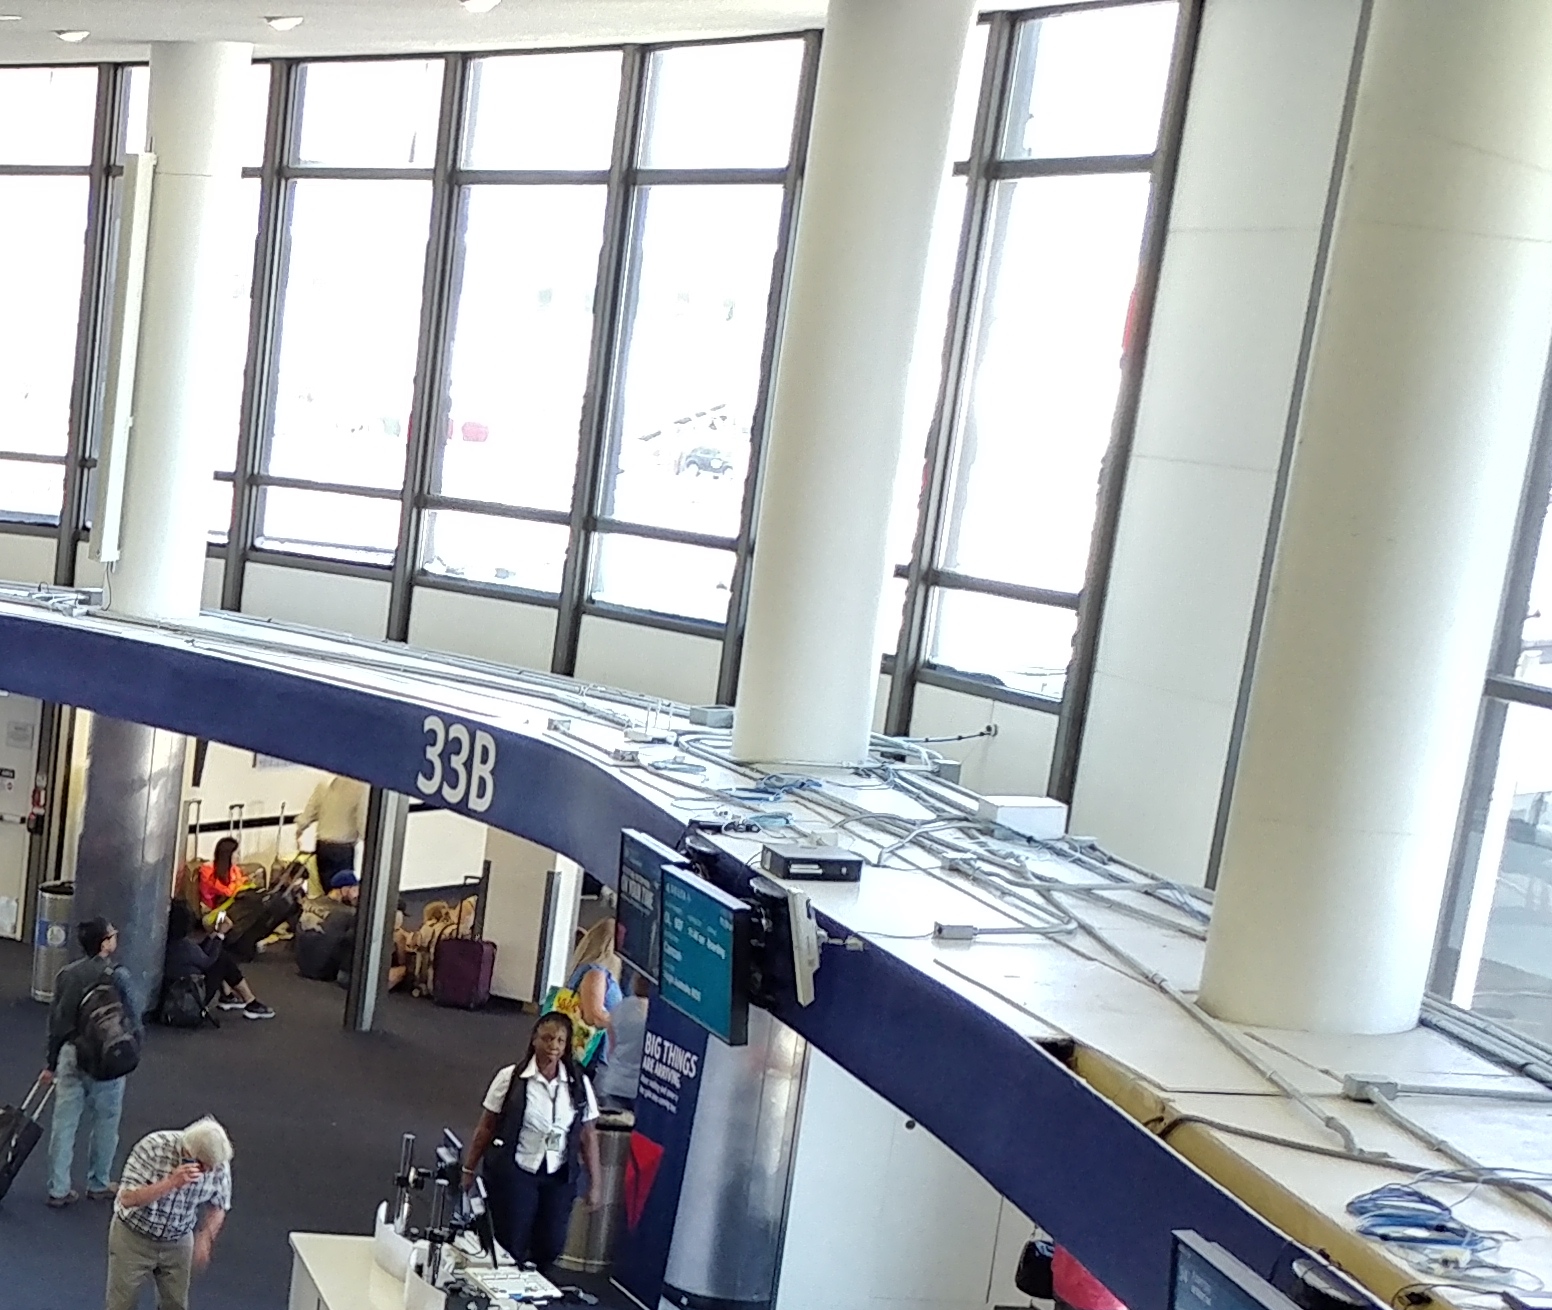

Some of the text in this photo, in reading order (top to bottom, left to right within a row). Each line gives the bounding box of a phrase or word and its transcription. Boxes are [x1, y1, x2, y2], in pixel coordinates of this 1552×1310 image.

[416, 714, 497, 814] 33B
[642, 1054, 656, 1074] ARE
[644, 1030, 699, 1079] BIG THINGS
